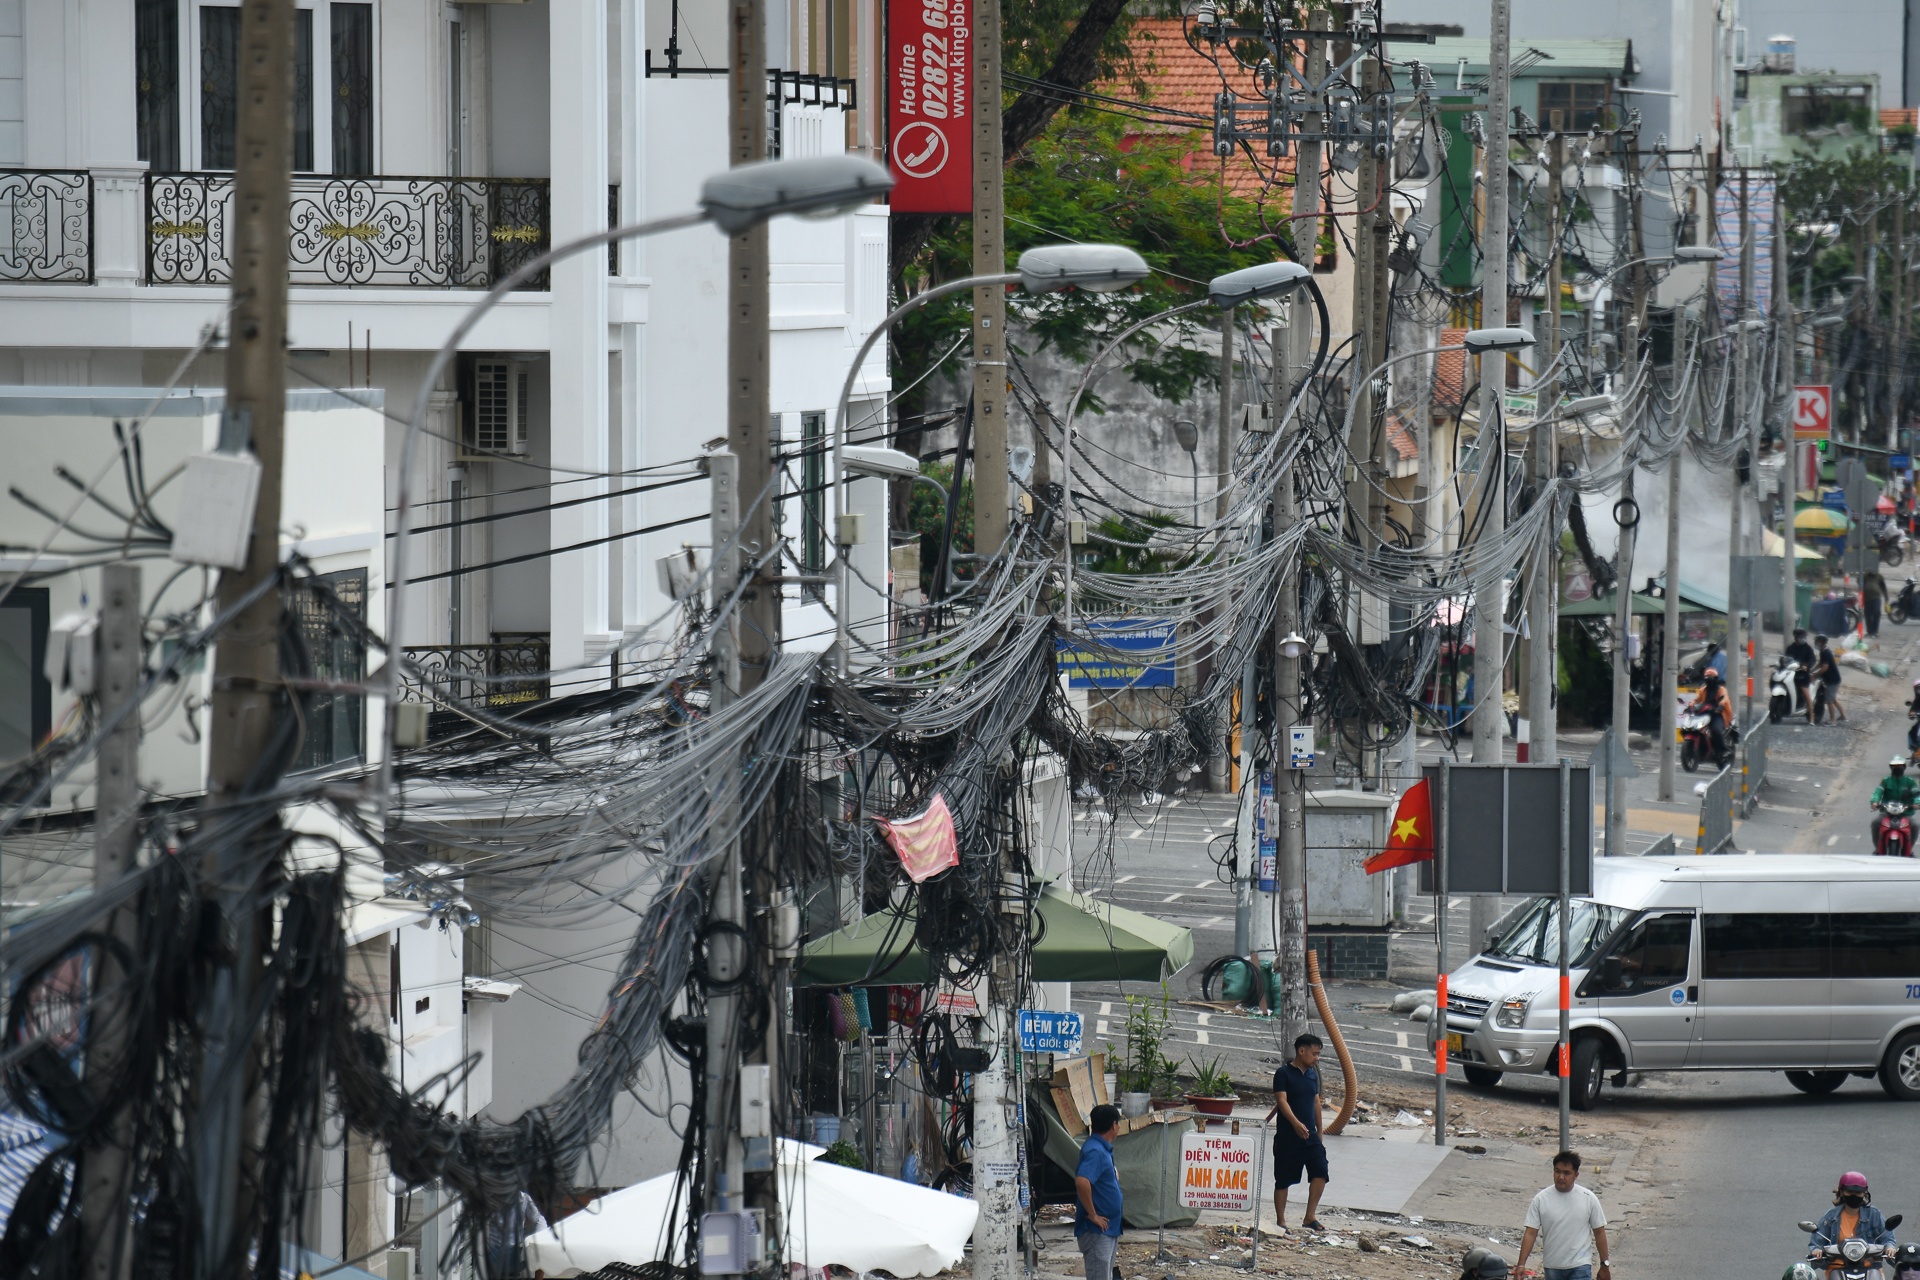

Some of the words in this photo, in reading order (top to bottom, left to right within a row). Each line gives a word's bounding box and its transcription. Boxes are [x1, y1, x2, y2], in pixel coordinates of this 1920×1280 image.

[950, 0, 969, 119] www.kingbb
[899, 44, 916, 115] Hotline
[922, 32, 948, 119] 02822
[1799, 397, 1823, 421] K
[1025, 1015, 1051, 1034] HẺM
[1057, 1021, 1078, 1035] 127
[1024, 1037, 1036, 1048] LỘ
[1039, 1036, 1061, 1048] GIỚI:
[1205, 1138, 1231, 1150] TIỆM
[1185, 1148, 1211, 1163] ĐIỆN
[1221, 1149, 1250, 1163] NƯỚC
[1185, 1163, 1212, 1188] ÁNH
[1215, 1165, 1249, 1190] SÁNG
[1196, 1190, 1216, 1199] HOÀNG
[1217, 1192, 1229, 1200] HOA
[1231, 1192, 1248, 1201] THÁM
